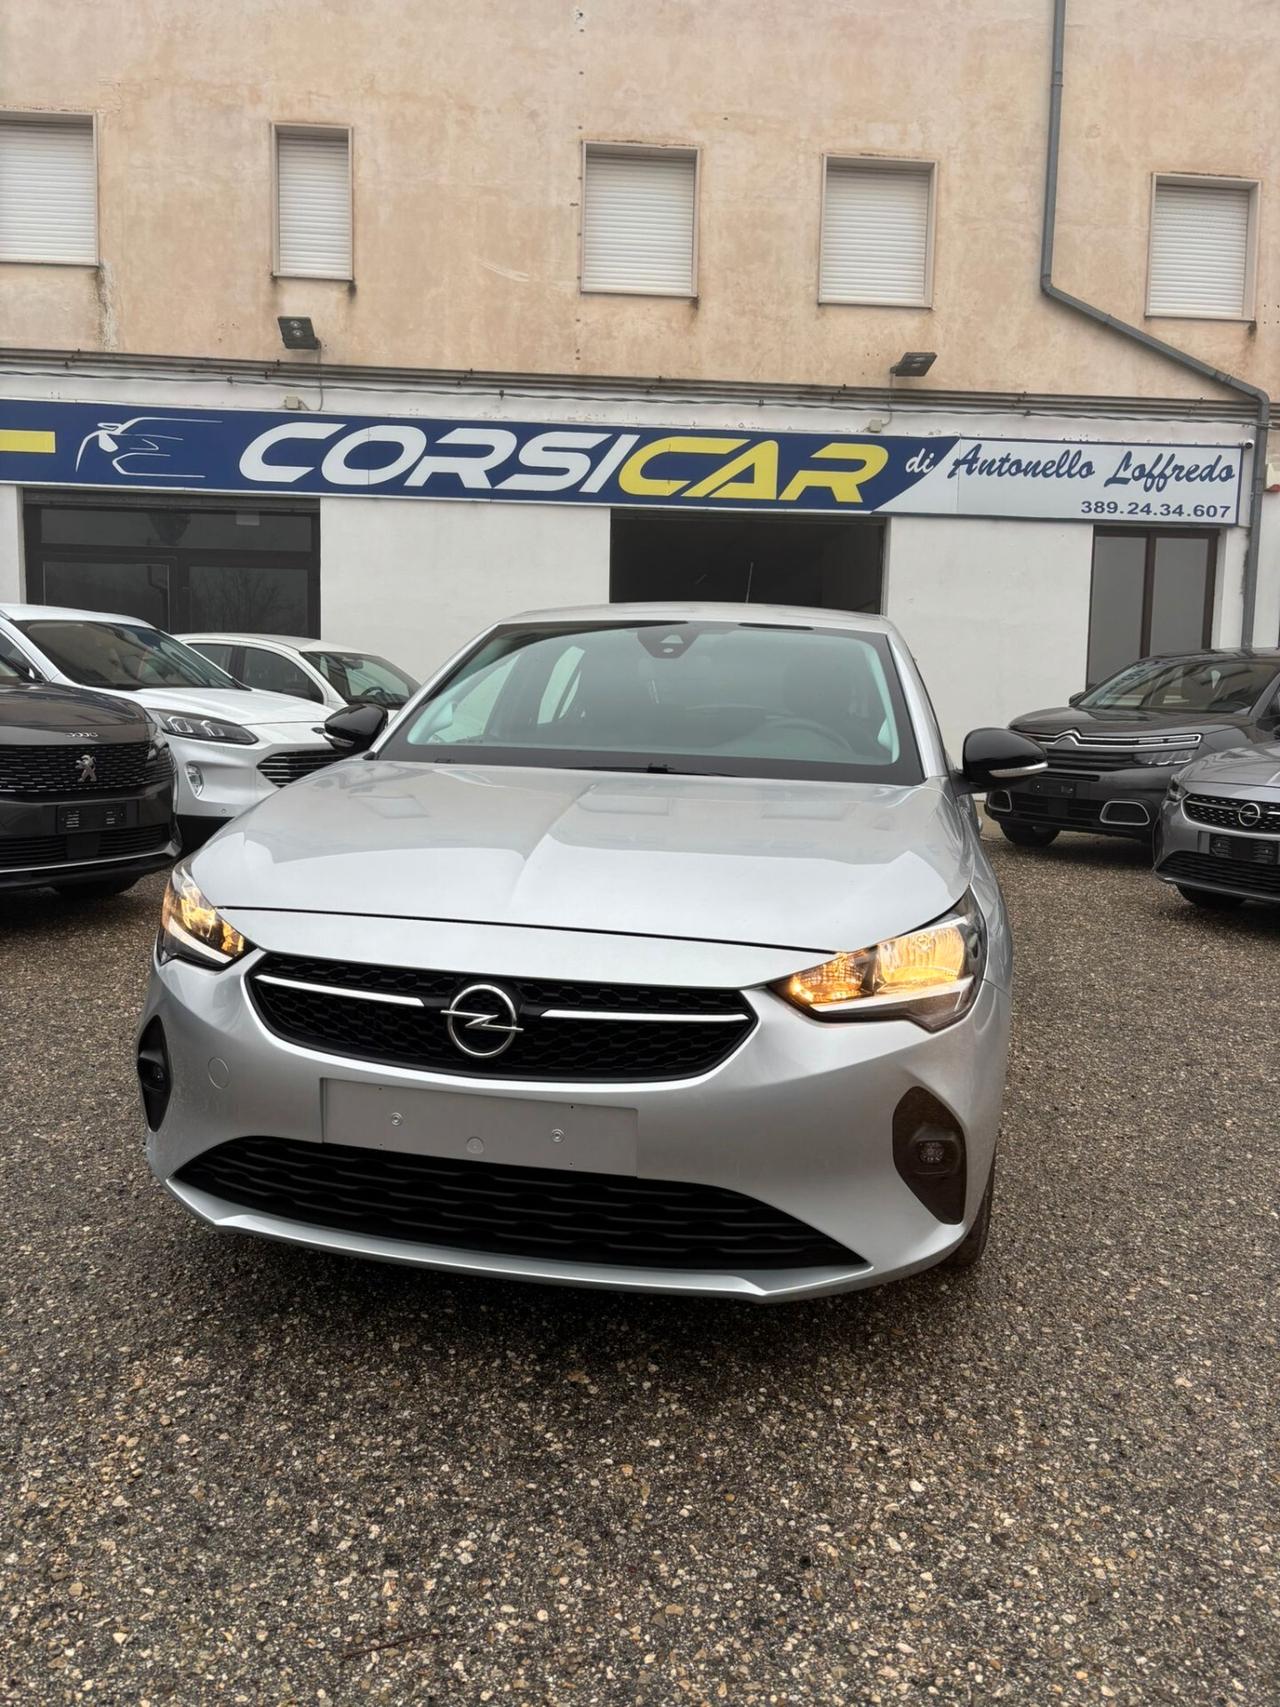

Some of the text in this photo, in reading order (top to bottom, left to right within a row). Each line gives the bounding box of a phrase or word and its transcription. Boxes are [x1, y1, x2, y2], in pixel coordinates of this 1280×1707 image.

[239, 421, 1235, 504] CORSICAR di Antonello Loffredo
[1080, 500, 1231, 518] 389.24.34.607
